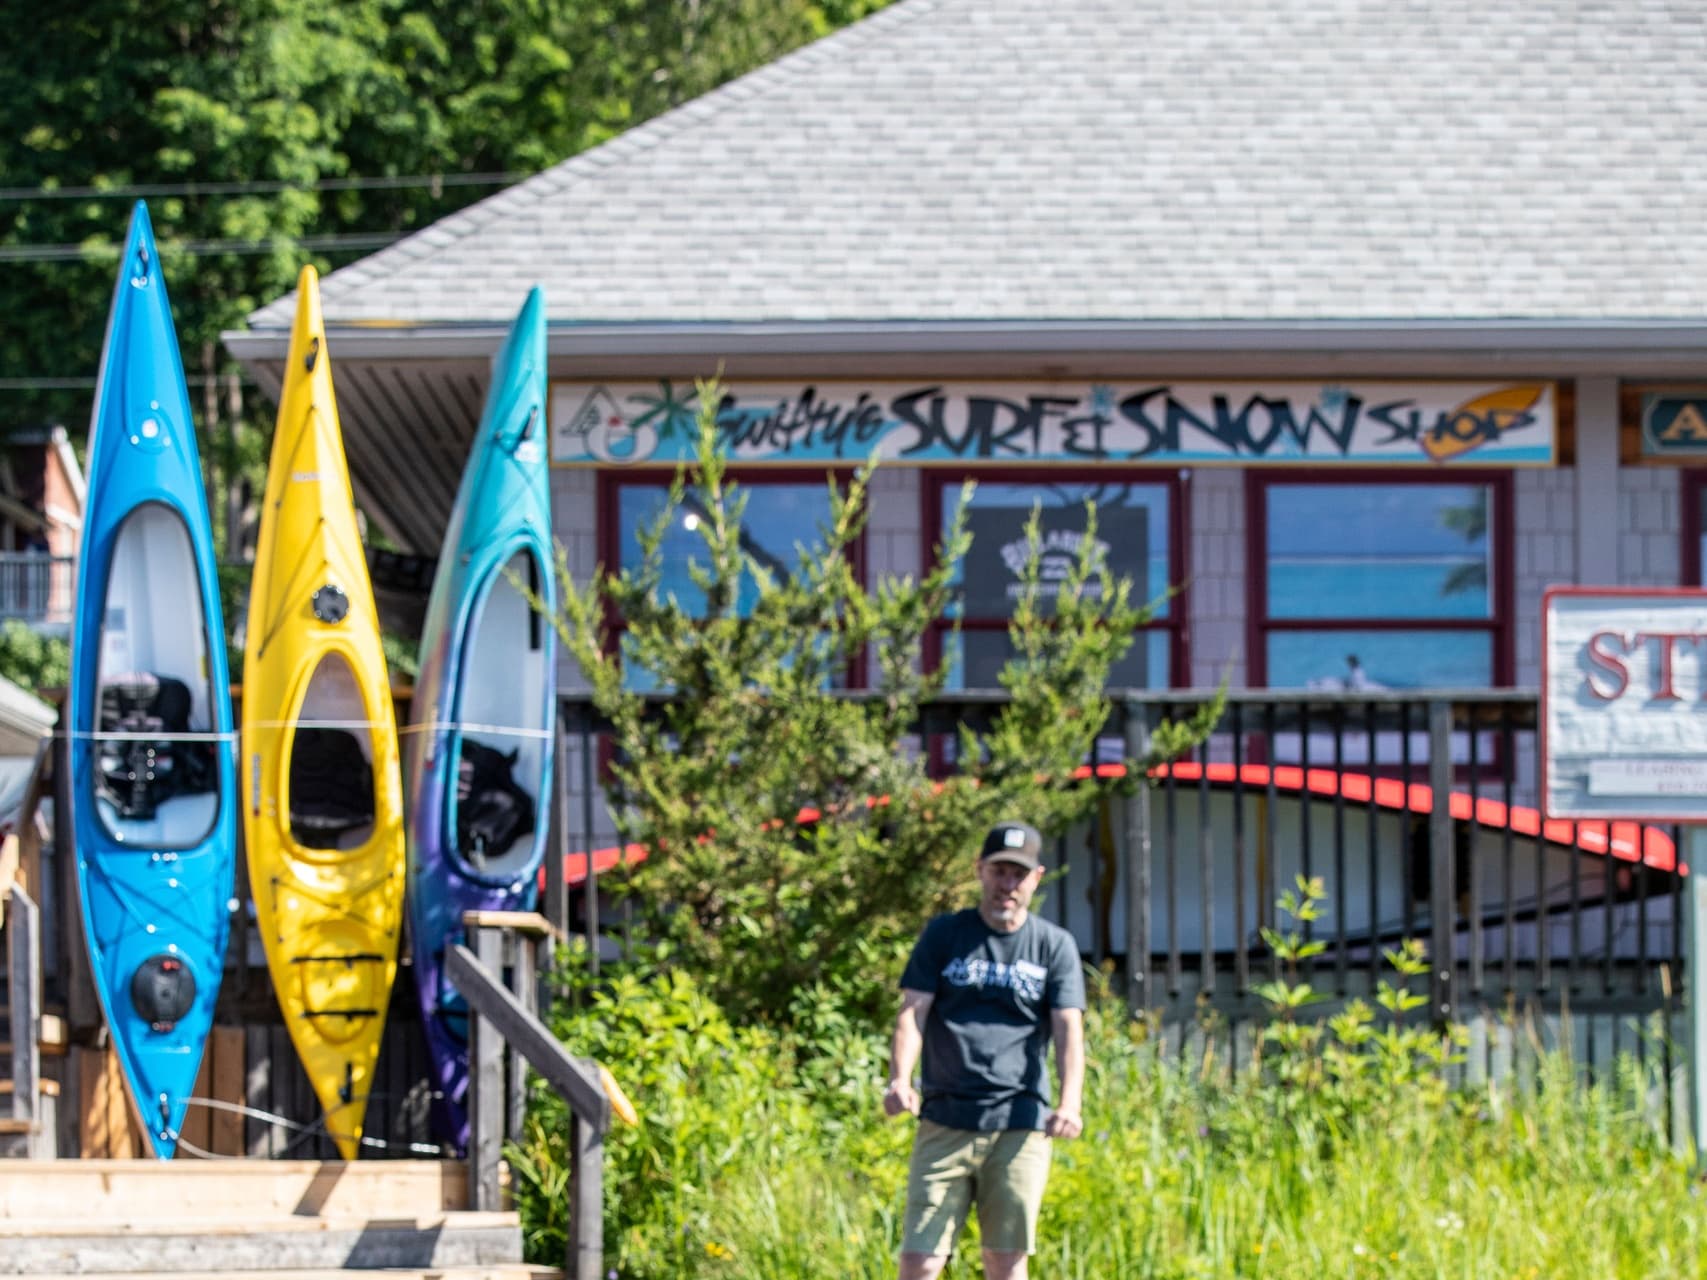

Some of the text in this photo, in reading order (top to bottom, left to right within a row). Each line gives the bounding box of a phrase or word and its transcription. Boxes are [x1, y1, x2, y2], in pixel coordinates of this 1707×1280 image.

[891, 386, 1079, 457] SURF
[1119, 386, 1364, 458] SNOW
[1366, 400, 1537, 446] SHOP
[1586, 632, 1707, 700] ST
